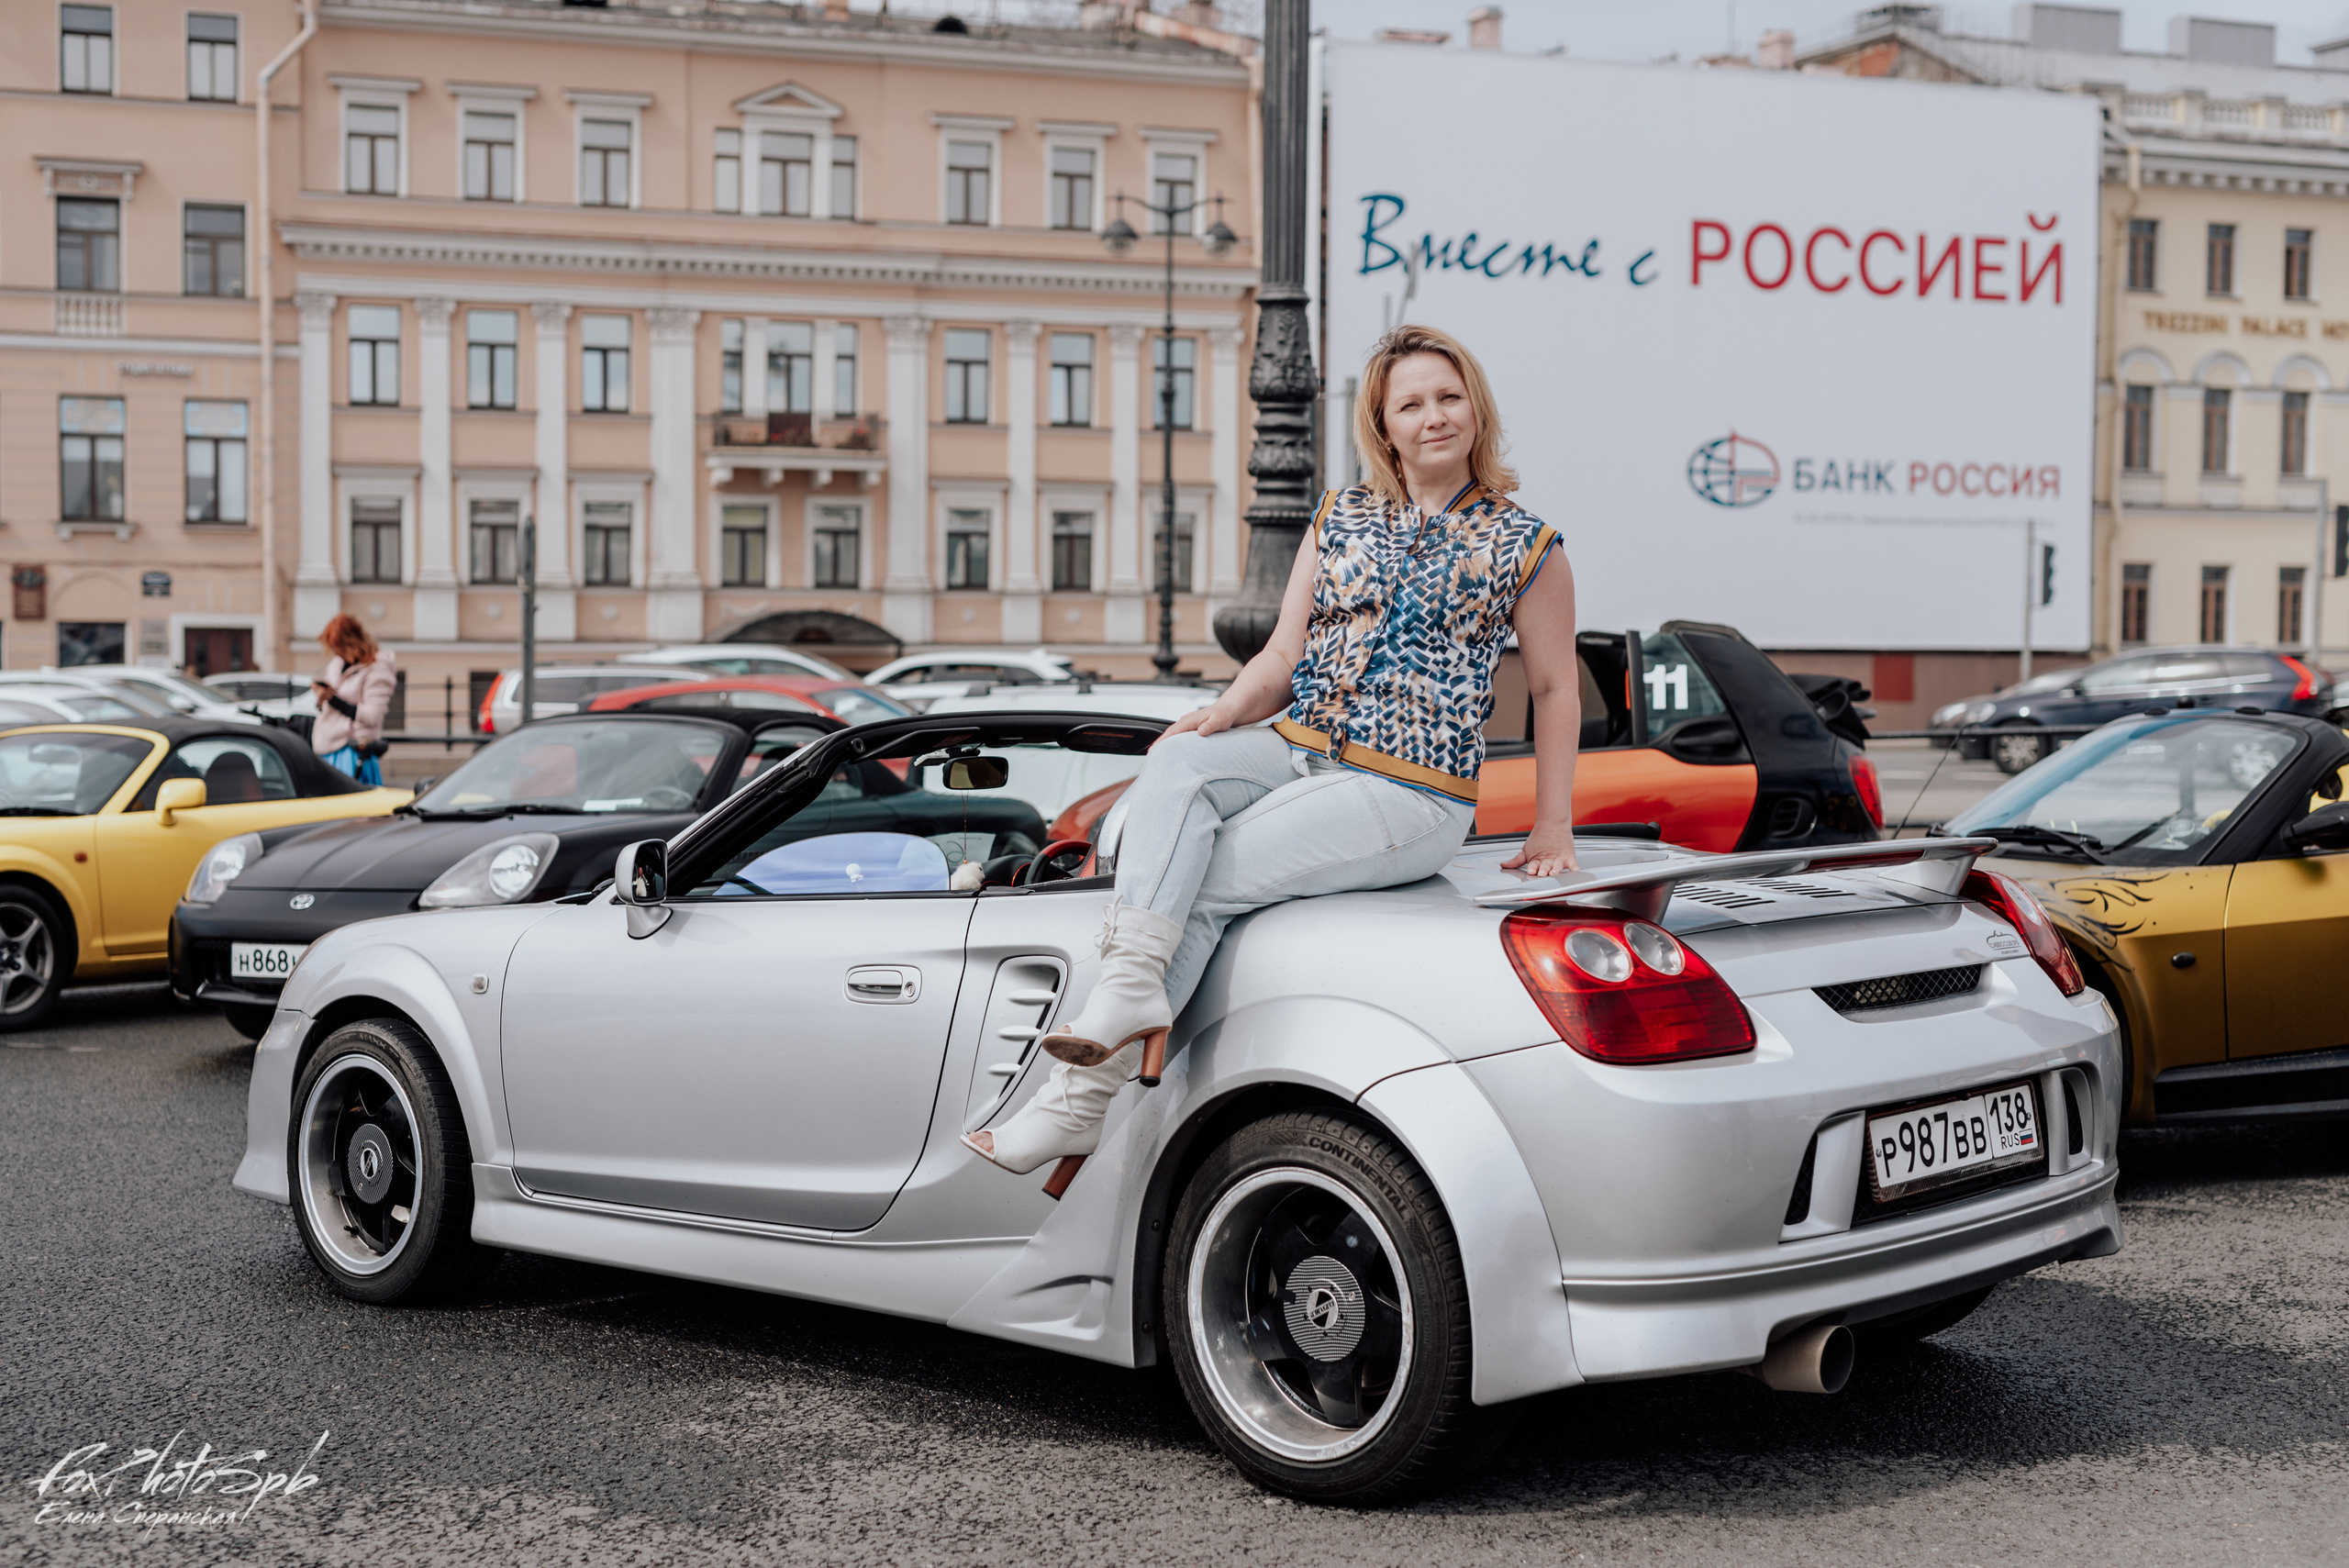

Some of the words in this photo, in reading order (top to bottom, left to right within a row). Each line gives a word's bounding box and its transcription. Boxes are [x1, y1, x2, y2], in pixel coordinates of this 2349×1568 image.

[1359, 194, 1601, 278] Вместе
[1629, 250, 1660, 286] с
[1690, 213, 2063, 305] РОССИЕЙ
[2143, 310, 2228, 335] TREZZINI
[2242, 316, 2307, 339] PALACE
[1794, 459, 1896, 494] БАНК
[1909, 461, 2061, 499] РОССИЯ
[1643, 663, 1688, 710] 11
[1989, 1092, 2027, 1135] 138
[2000, 1132, 2021, 1150] RUS
[1308, 1137, 1408, 1220] CONTINENTAL
